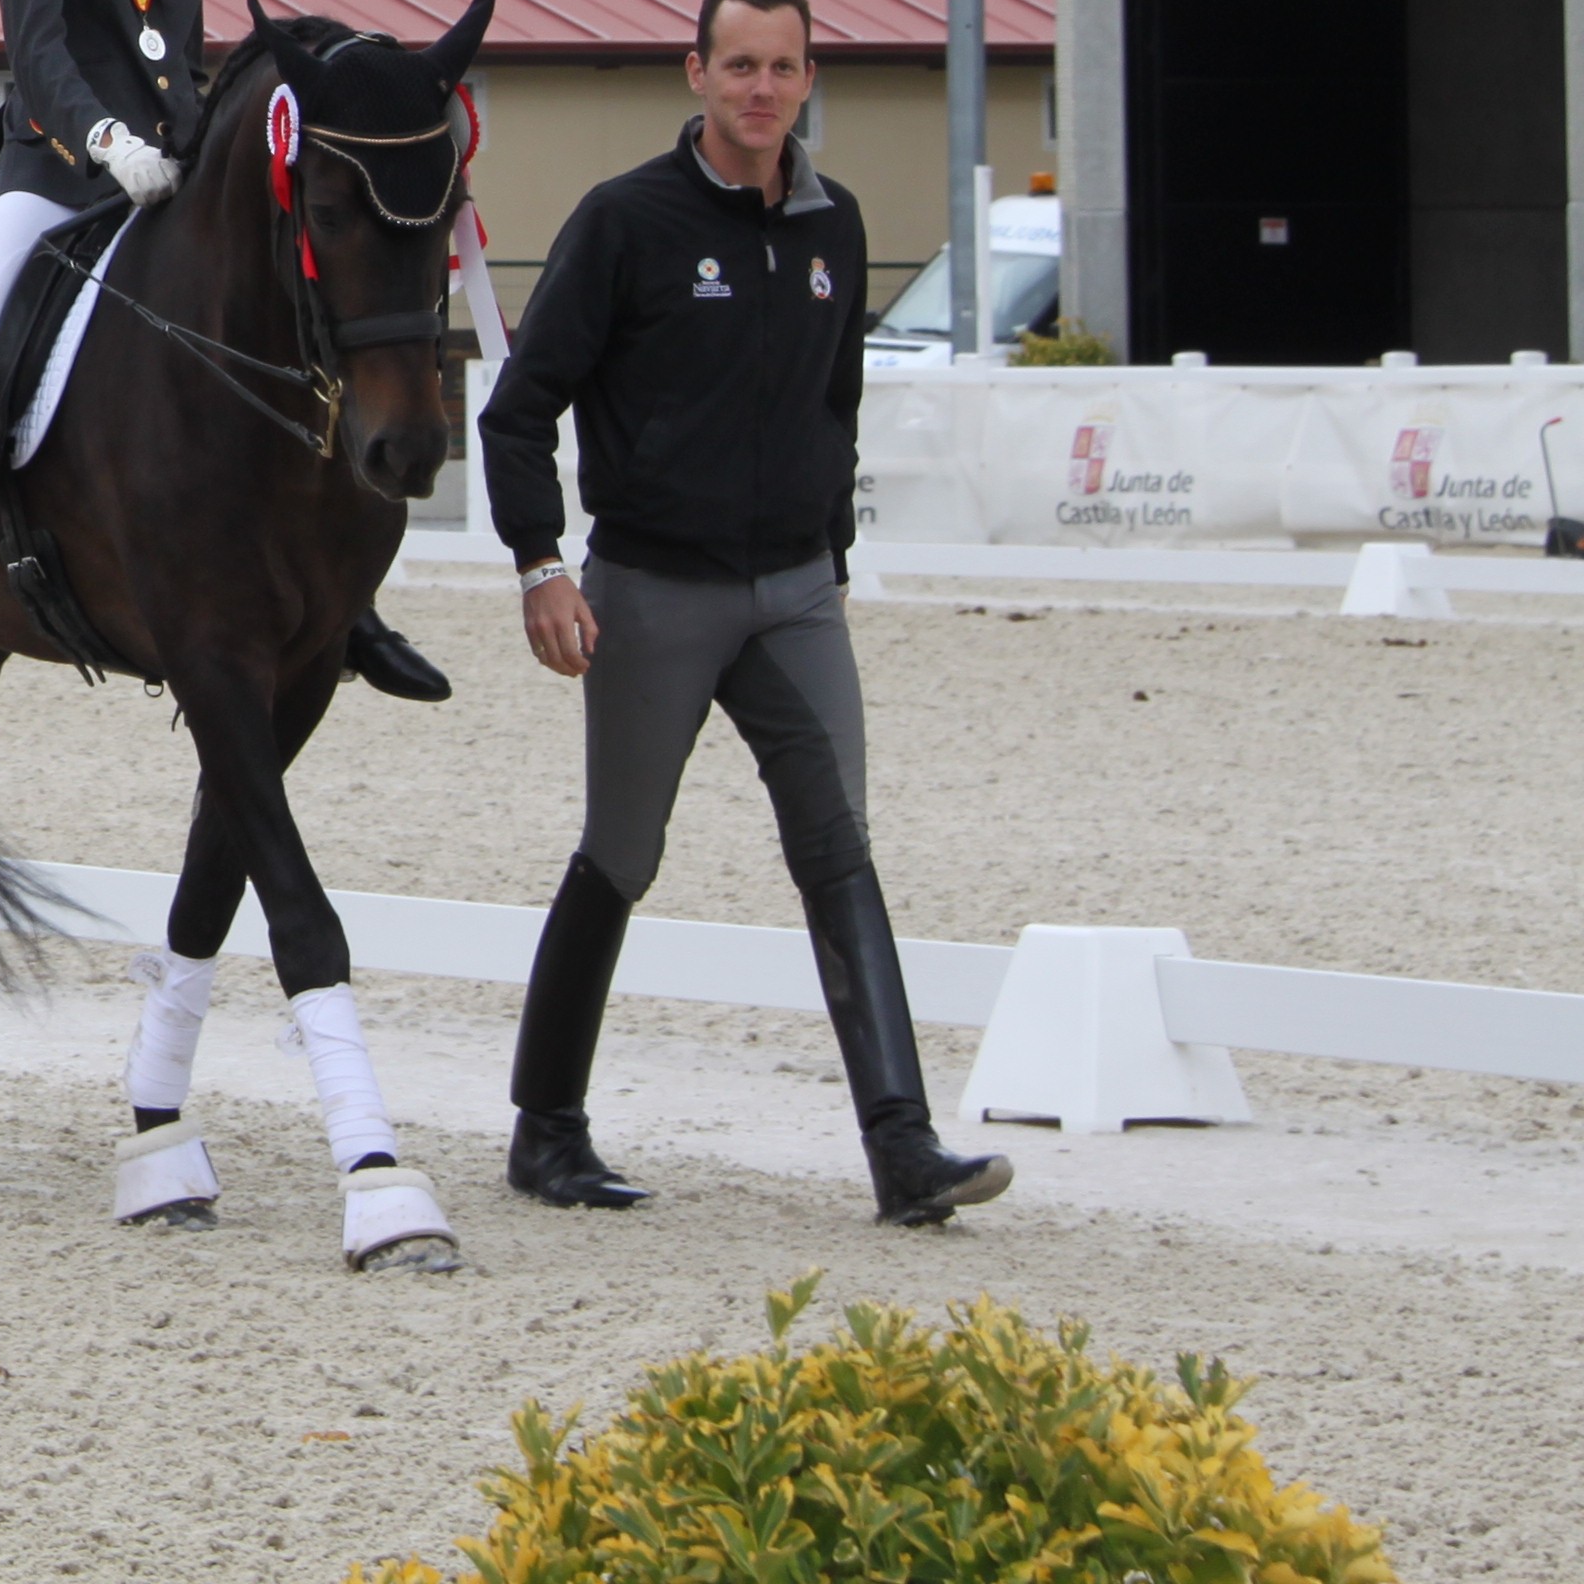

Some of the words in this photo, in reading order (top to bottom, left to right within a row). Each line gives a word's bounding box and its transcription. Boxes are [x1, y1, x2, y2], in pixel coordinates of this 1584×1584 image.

[1107, 470, 1163, 492] Junta
[1167, 470, 1193, 493] de
[1436, 474, 1497, 498] Junta
[1502, 474, 1531, 499] de
[1125, 506, 1137, 532] y
[1142, 502, 1191, 526] León
[1459, 512, 1472, 539] y
[1478, 508, 1536, 532] León
